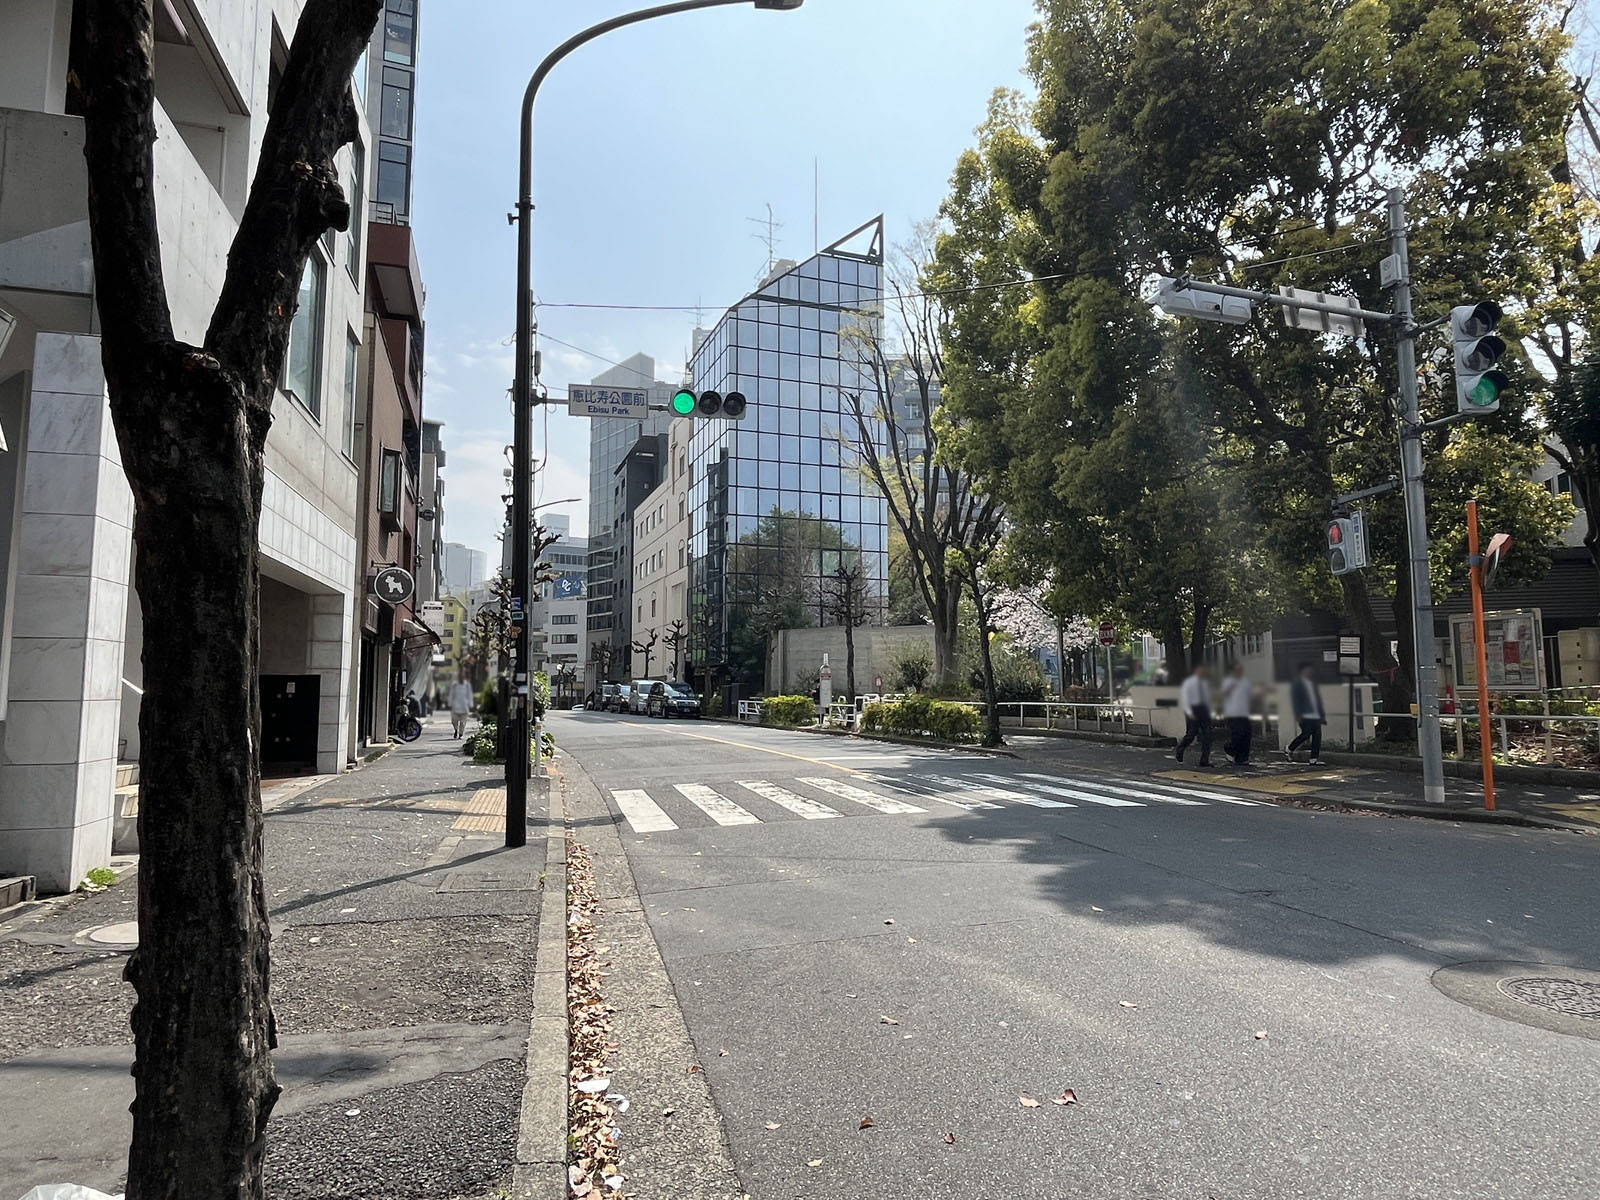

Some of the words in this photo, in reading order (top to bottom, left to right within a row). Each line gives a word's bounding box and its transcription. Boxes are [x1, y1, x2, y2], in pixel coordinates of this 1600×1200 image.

[573, 389, 644, 406] 恵比寿公園前
[588, 405, 609, 414] Ebisu
[612, 407, 630, 415] Park
